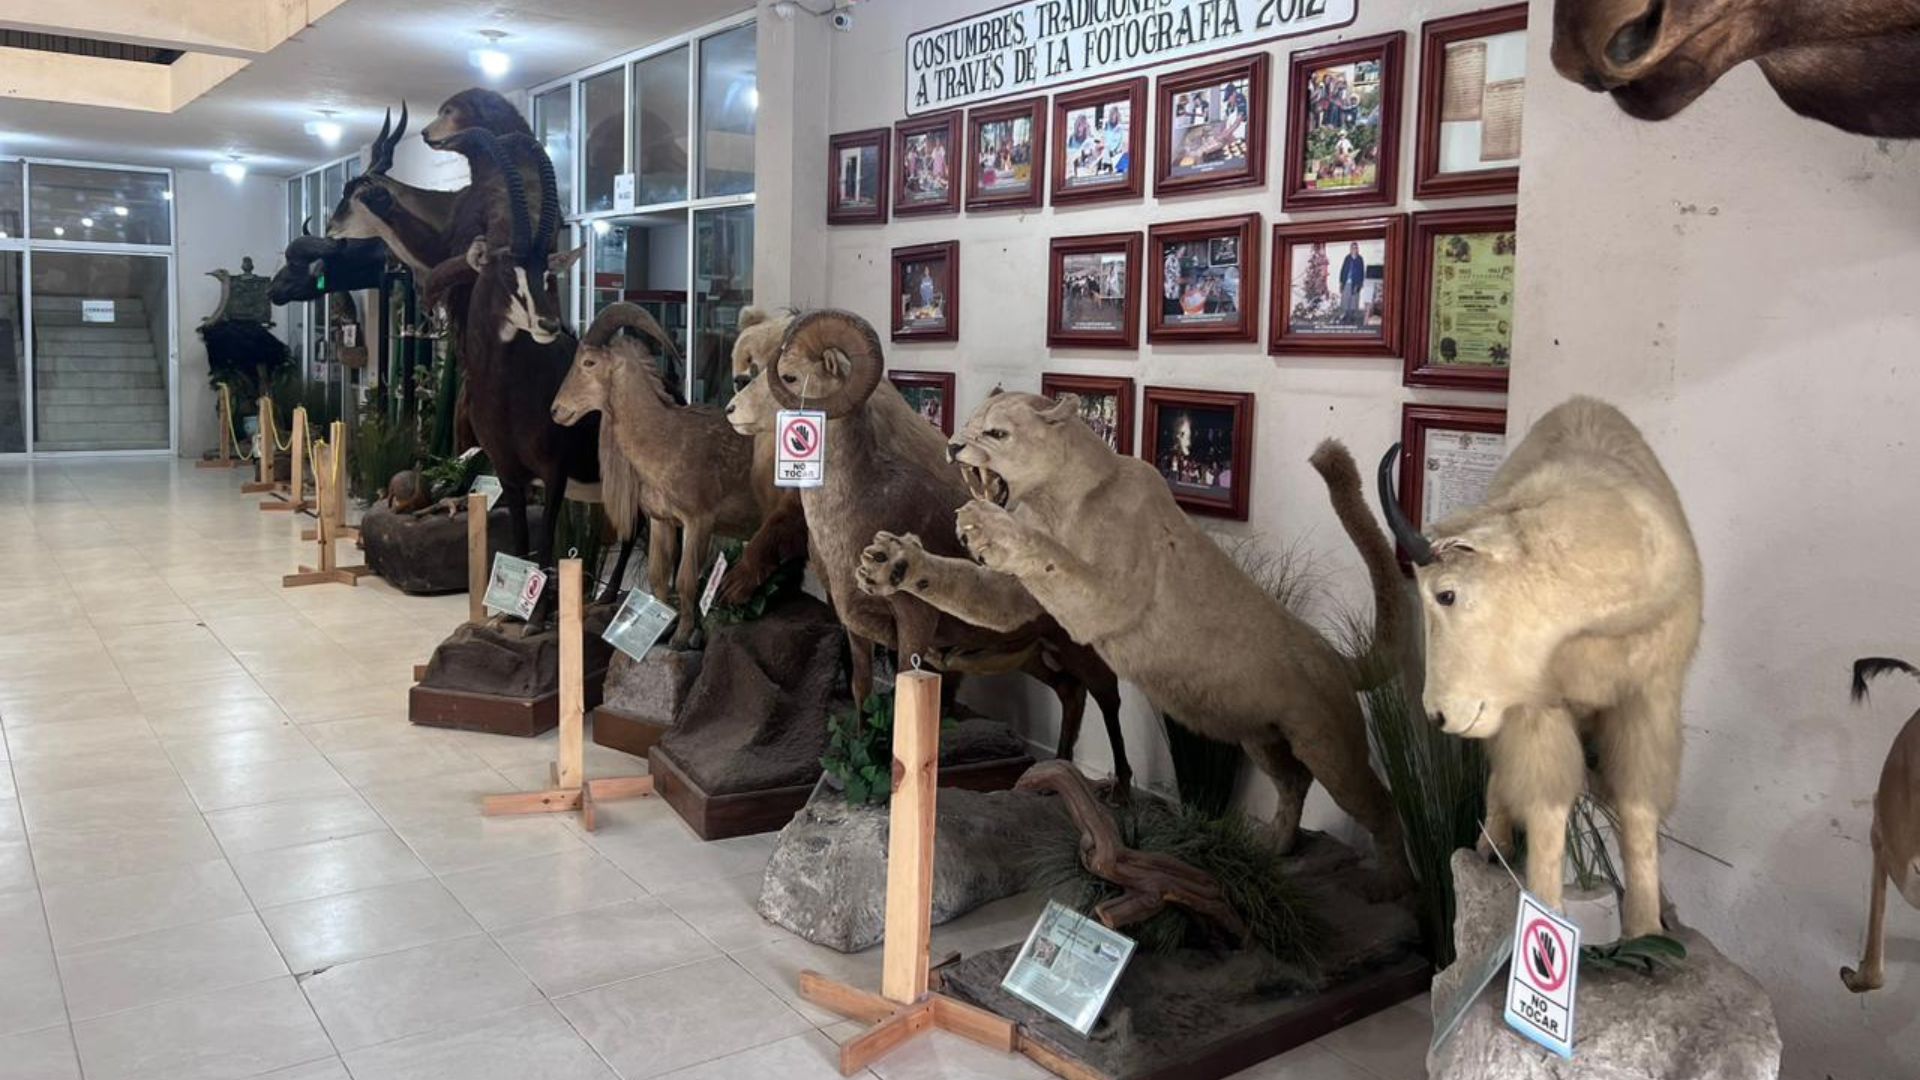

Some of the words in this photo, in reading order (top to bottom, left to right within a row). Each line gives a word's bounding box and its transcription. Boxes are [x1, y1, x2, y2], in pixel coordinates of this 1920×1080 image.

[913, 10, 1028, 72] COSTUMBRES,
[1036, 0, 1172, 39] TRADICIO
[915, 72, 930, 107] A
[935, 53, 1005, 101] TRAVÉS
[1014, 45, 1037, 85] DE
[1045, 36, 1073, 78] LA
[784, 470, 815, 478] TOCAR
[793, 462, 806, 470] NO
[1519, 1000, 1559, 1033] TOCAR
[1531, 994, 1548, 1013] NO
